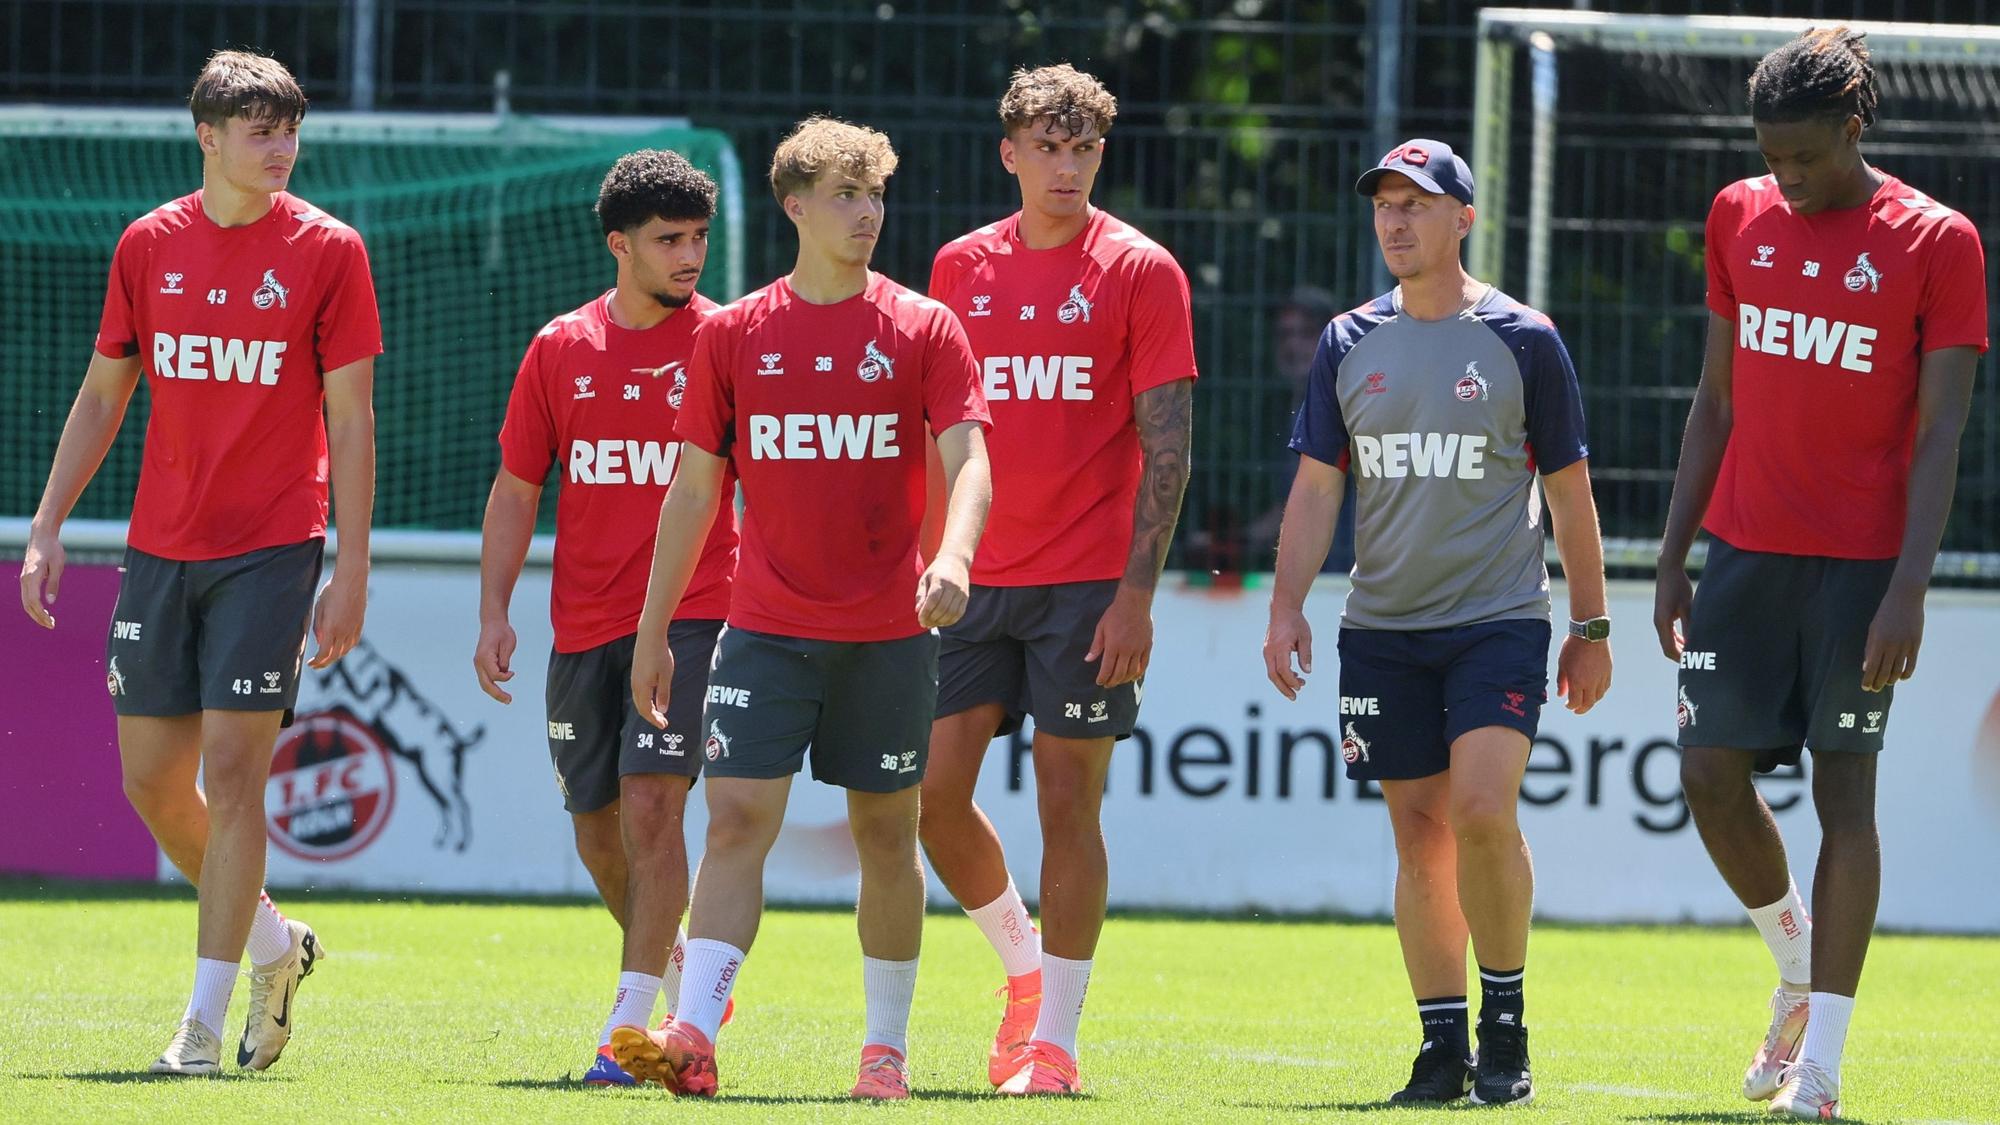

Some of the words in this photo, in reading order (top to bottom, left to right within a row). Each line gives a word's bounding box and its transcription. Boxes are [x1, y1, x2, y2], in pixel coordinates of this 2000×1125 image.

[1384, 145, 1430, 168] FC
[1750, 259, 1773, 268] hummel
[1802, 260, 1820, 278] 38
[160, 286, 183, 295] hummel
[206, 288, 227, 305] 43
[968, 308, 992, 318] hummel
[1019, 305, 1036, 321] 24
[1739, 303, 1878, 373] REWE
[153, 332, 288, 386] REWE
[815, 356, 833, 372] 36
[757, 367, 784, 376] hummel
[976, 355, 1094, 401] EWE
[623, 384, 641, 400] 34
[749, 413, 901, 460] REWE
[569, 439, 685, 486] REW
[1354, 432, 1488, 480] REWE
[1680, 651, 1717, 671] EWE
[232, 678, 252, 695] 43
[1065, 702, 1082, 719] 24
[1339, 696, 1381, 716] EWE
[1838, 712, 1856, 728] 38
[637, 732, 654, 749] 34
[659, 747, 685, 757] hummel
[880, 753, 899, 770] 36
